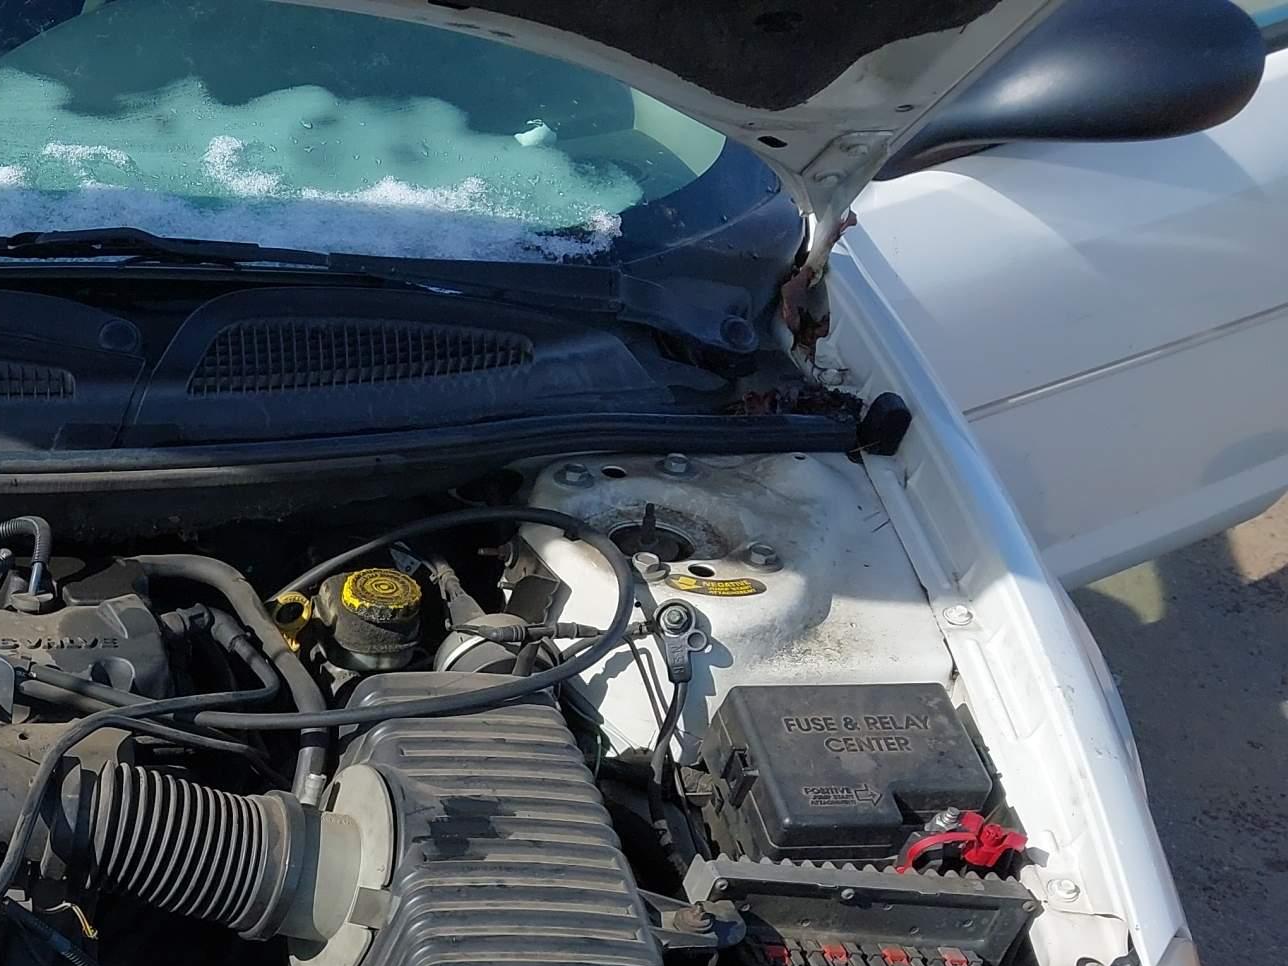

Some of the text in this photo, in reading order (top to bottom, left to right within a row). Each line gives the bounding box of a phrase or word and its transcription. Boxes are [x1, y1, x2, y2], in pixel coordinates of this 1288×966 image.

[783, 715, 930, 733] FUSE & RELAY
[824, 736, 912, 752] CENTER
[803, 787, 853, 795] POSITIVE
